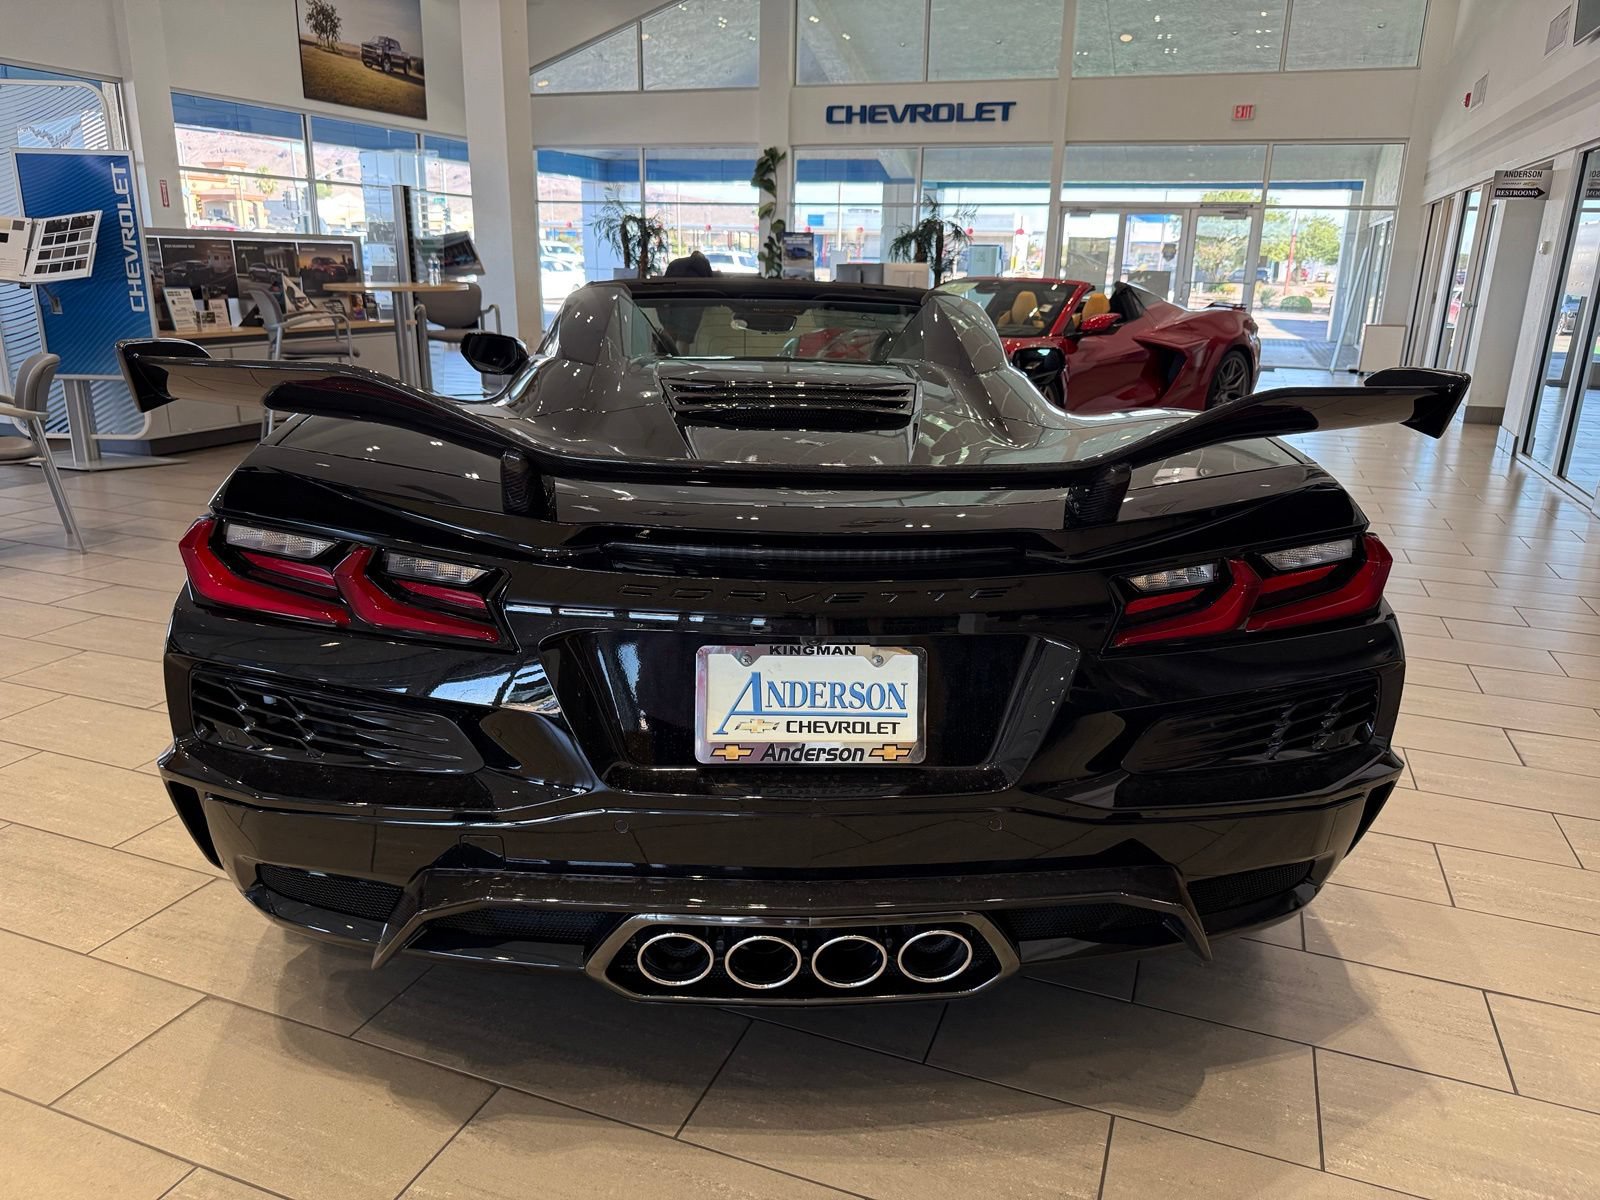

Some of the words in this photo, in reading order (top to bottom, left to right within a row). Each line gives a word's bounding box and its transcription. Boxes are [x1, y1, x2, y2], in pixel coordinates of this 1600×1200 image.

[826, 101, 1017, 124] CHEVROLET
[1234, 104, 1254, 119] EXIT
[1503, 170, 1543, 178] ANDERSON
[1496, 188, 1539, 196] RESTROOMS
[110, 162, 146, 312] CHEVROLET
[617, 582, 1022, 604] CORVETTE
[769, 645, 857, 656] KINGMAN
[712, 671, 908, 735] ANDERSON
[785, 720, 901, 735] CHEVROLET
[760, 743, 865, 762] Anderson
